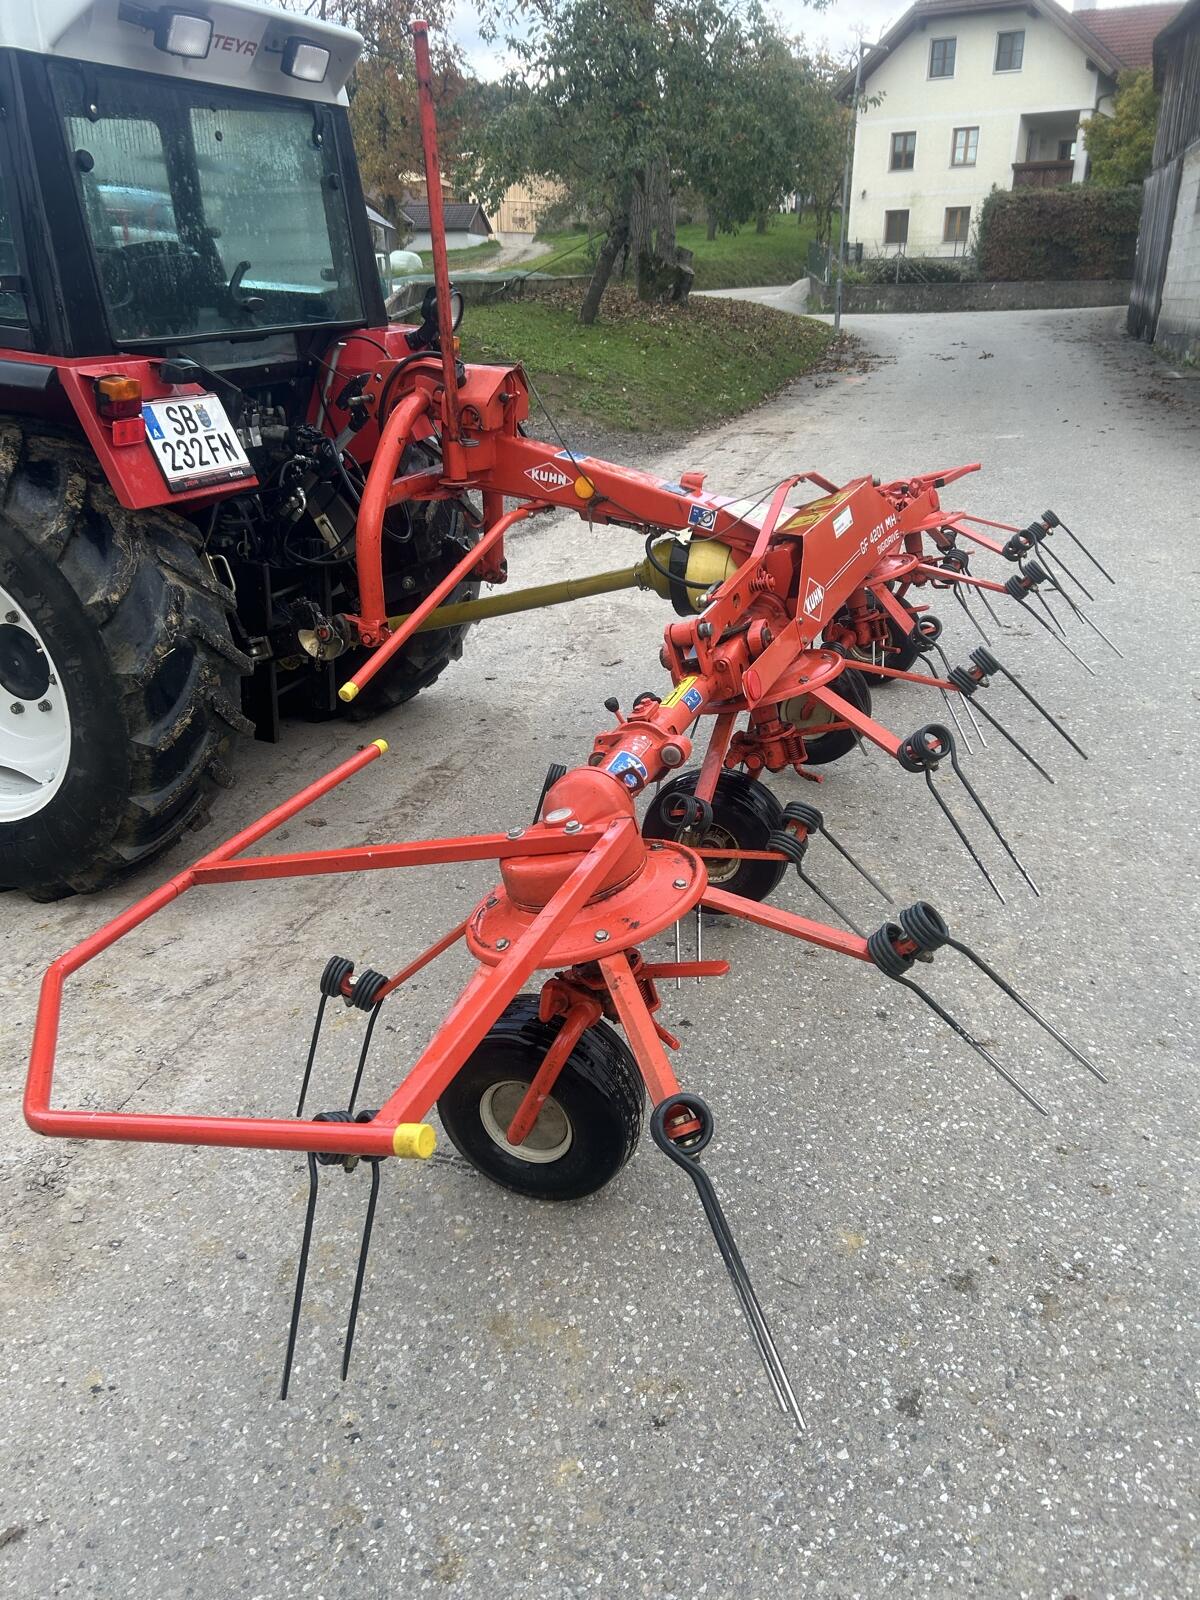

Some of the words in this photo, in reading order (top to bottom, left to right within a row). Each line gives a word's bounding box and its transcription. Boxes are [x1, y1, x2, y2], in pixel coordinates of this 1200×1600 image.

[213, 33, 258, 57] TEYR
[153, 428, 161, 438] A
[165, 405, 199, 436] SB
[531, 468, 567, 486] KUHN
[859, 537, 869, 555] GF
[869, 522, 885, 544] 4201
[884, 512, 897, 531] MH
[876, 529, 900, 556] DIGIDRIVE
[805, 585, 824, 615] KUHN
